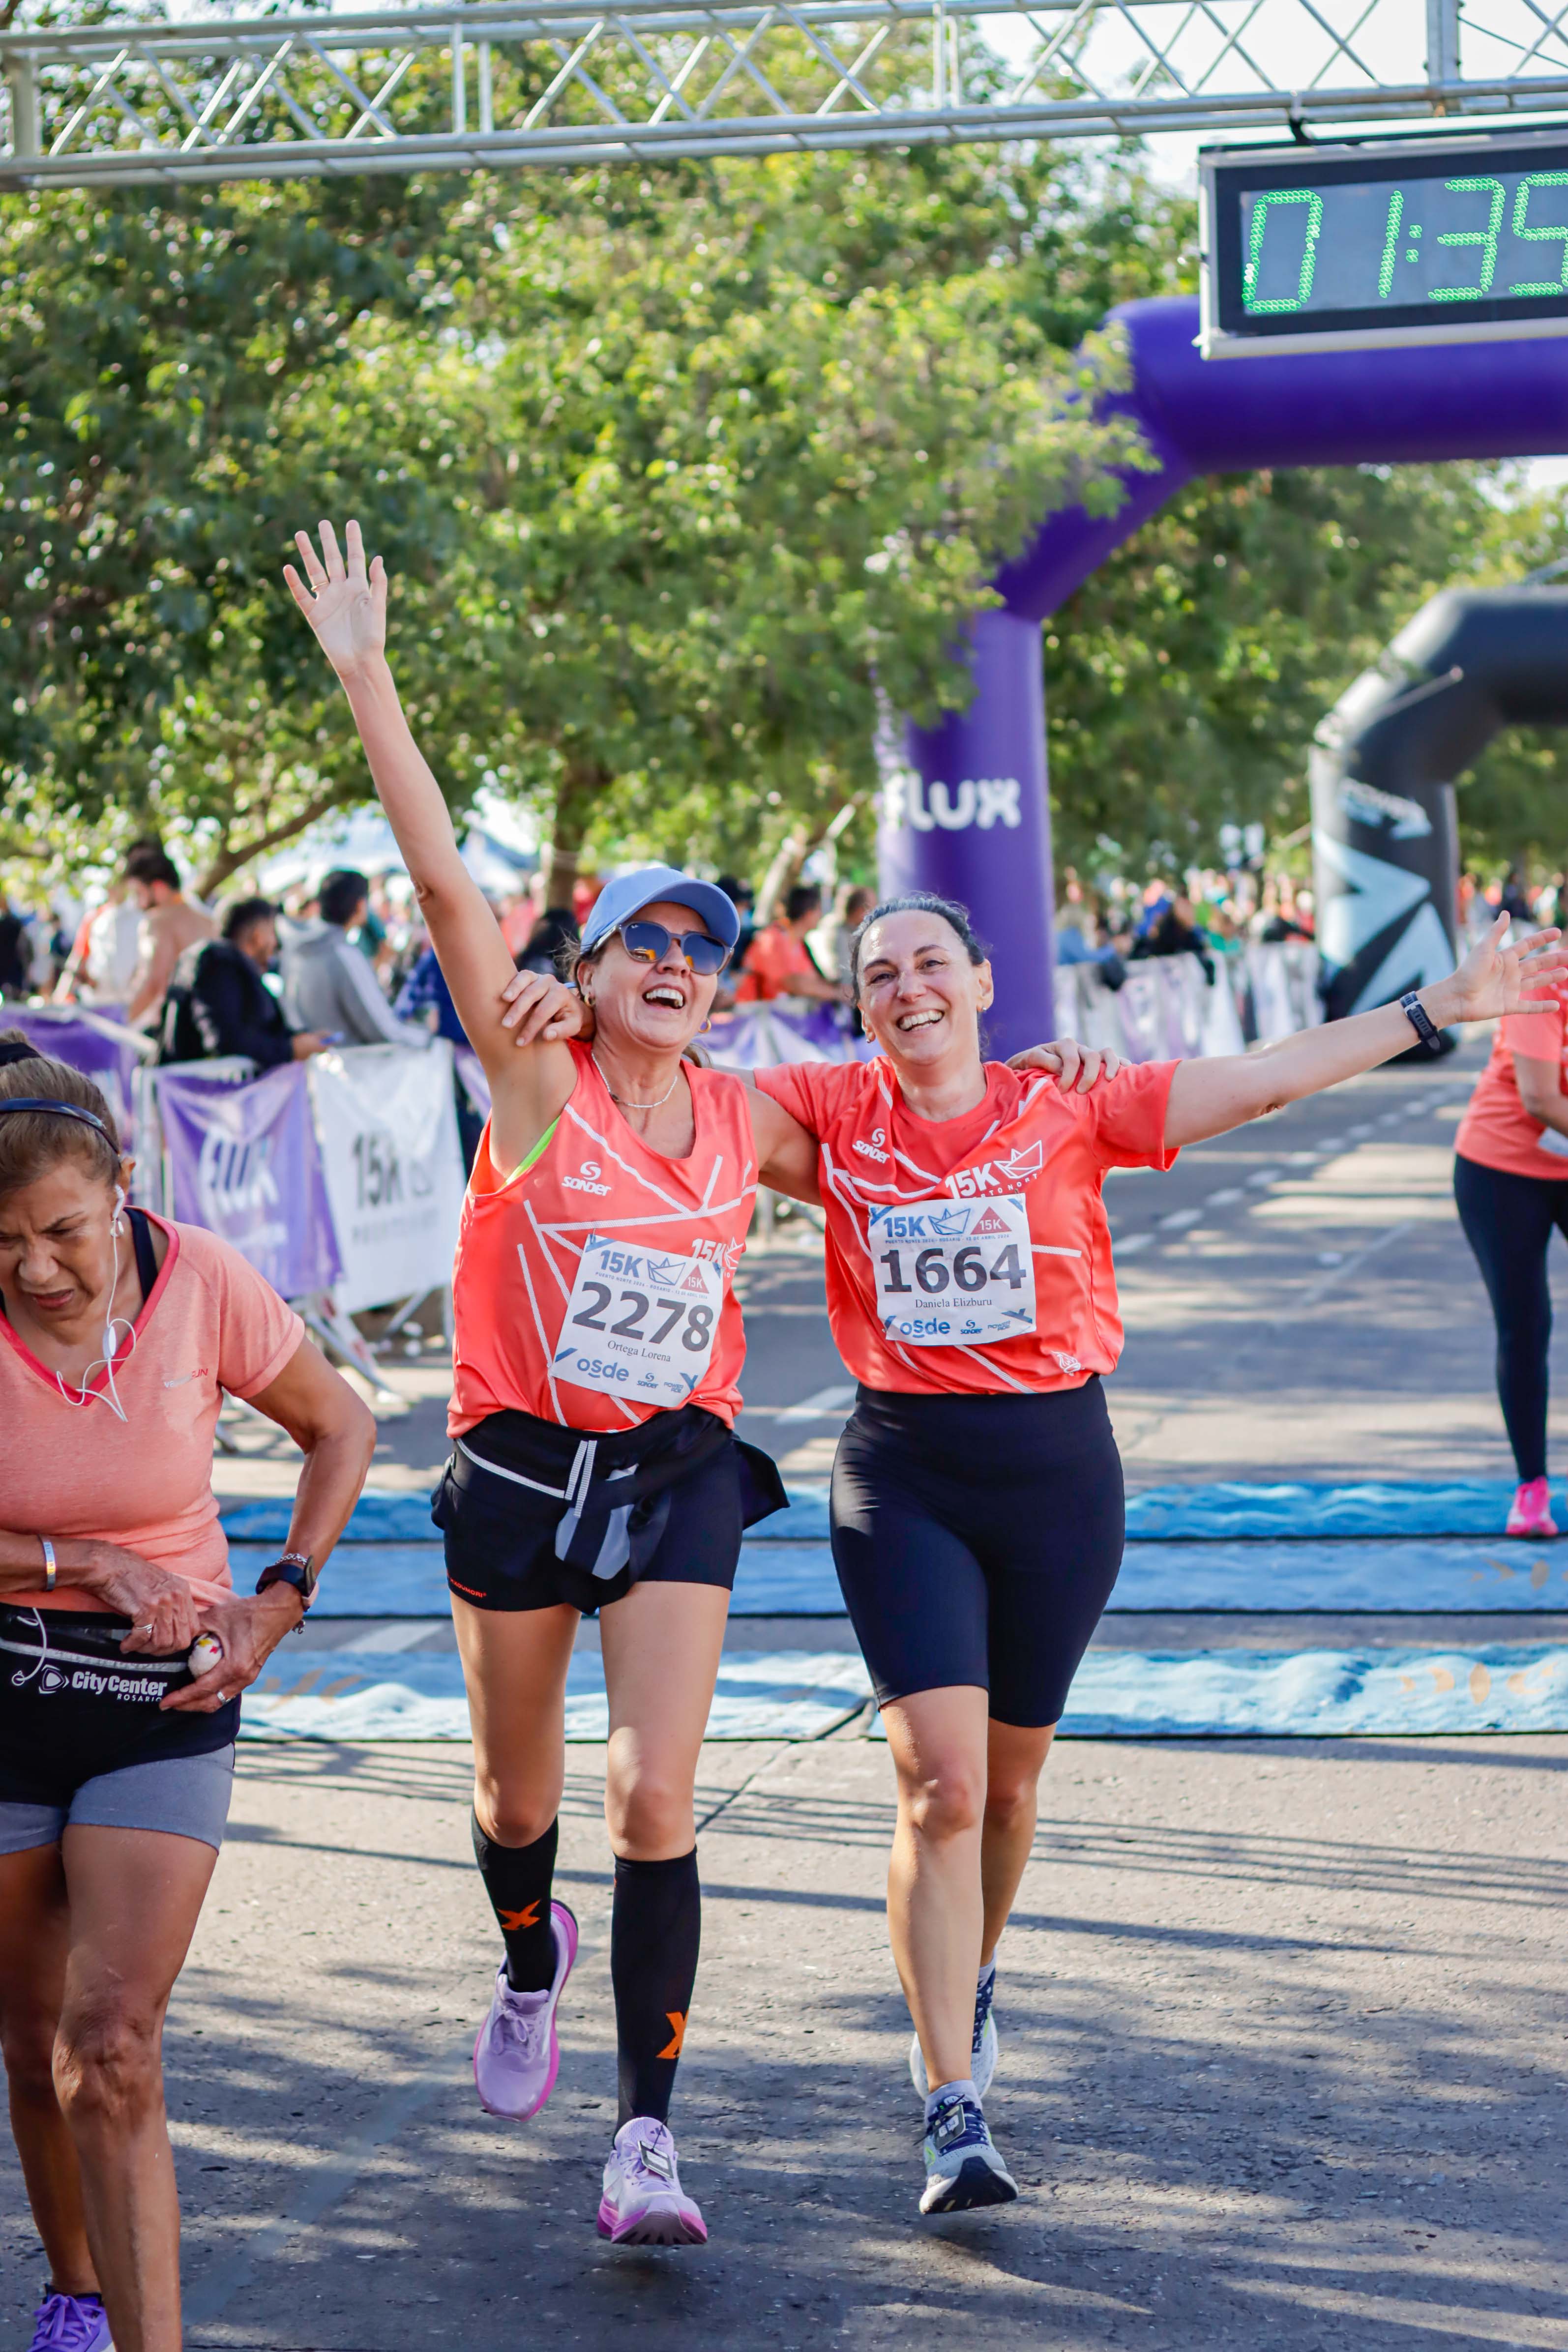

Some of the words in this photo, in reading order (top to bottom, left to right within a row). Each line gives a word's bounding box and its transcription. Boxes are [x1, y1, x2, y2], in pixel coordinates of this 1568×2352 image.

[852, 1140, 890, 1164] SONDer
[562, 1176, 611, 1196] SONDer
[945, 1162, 1000, 1199] 15K
[884, 1215, 925, 1237] 15K
[979, 1218, 1002, 1230] 15K
[600, 1250, 643, 1278] 15K
[880, 1243, 1027, 1294] 1664
[688, 1276, 703, 1289] 15K
[915, 1298, 950, 1308] Daniela
[953, 1297, 992, 1308] Elizburu
[572, 1281, 713, 1352] 2278
[900, 1318, 950, 1338] osde
[608, 1340, 639, 1356] Ortega
[641, 1348, 671, 1362] Lorena
[577, 1358, 629, 1382] osde
